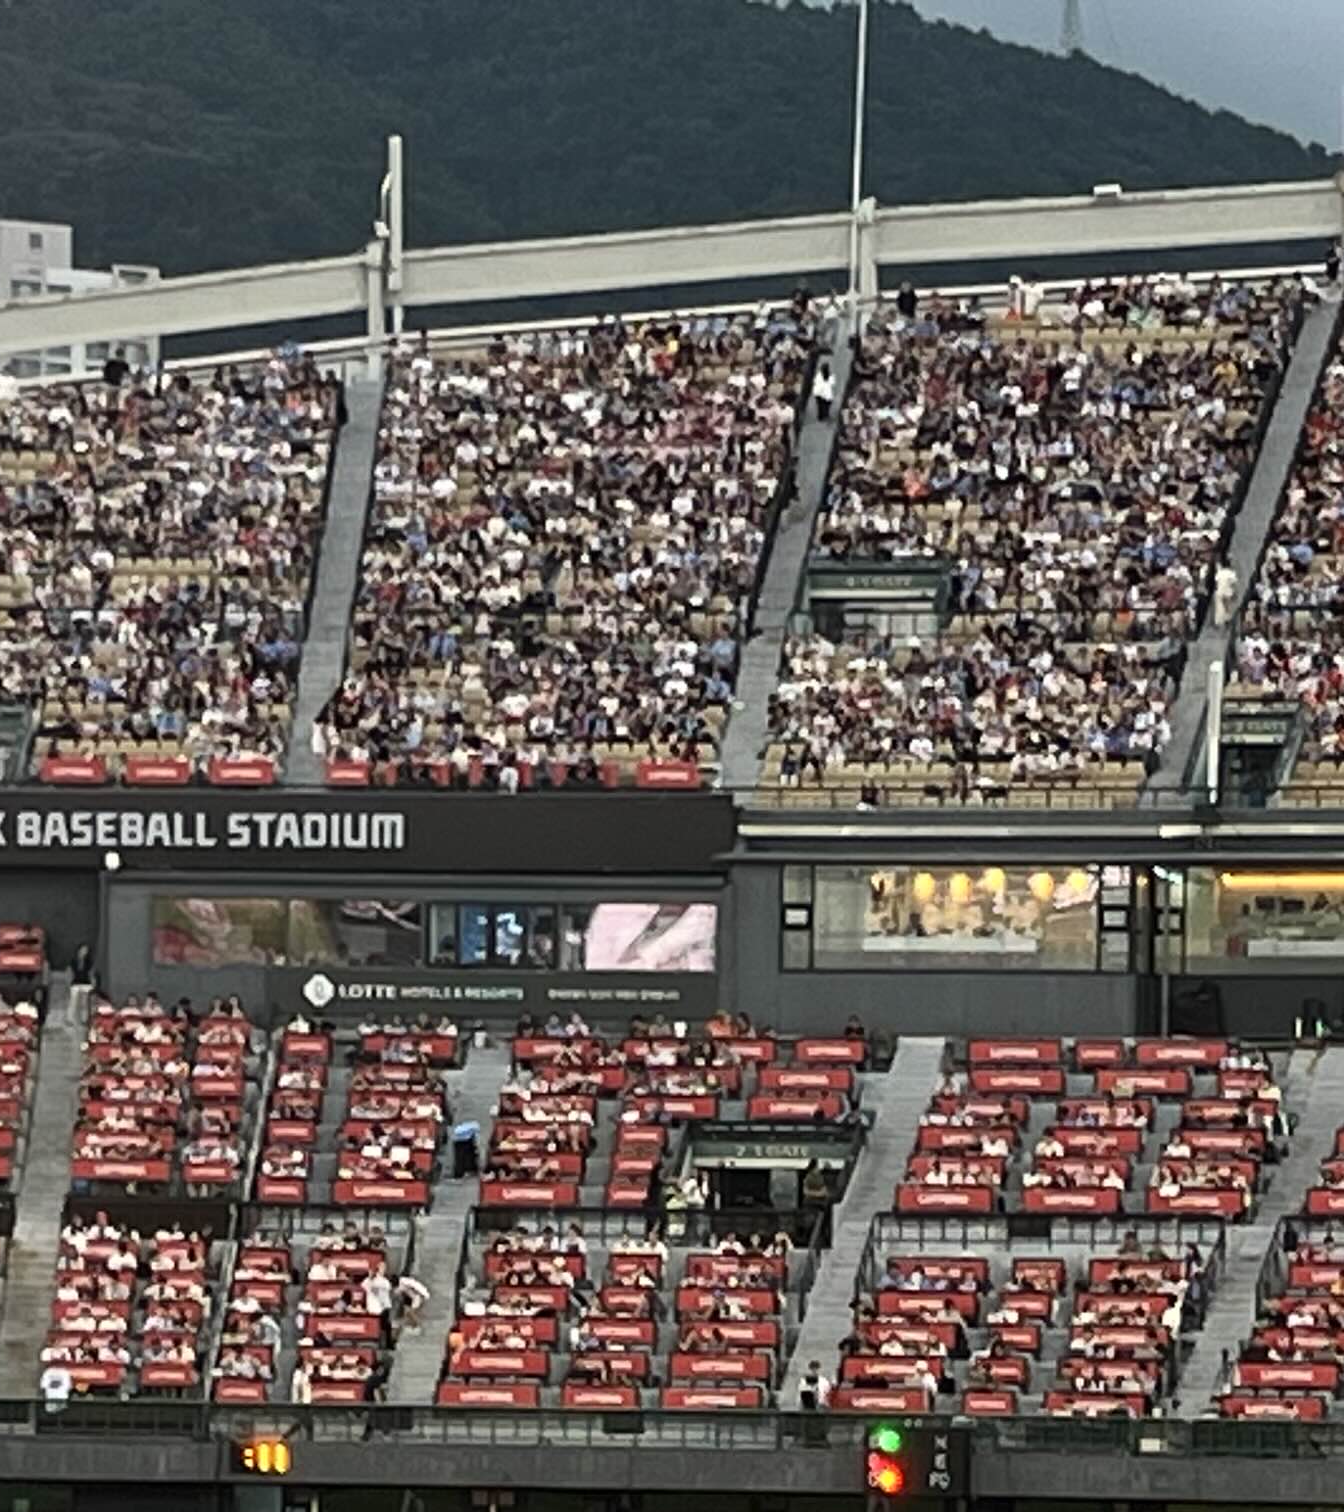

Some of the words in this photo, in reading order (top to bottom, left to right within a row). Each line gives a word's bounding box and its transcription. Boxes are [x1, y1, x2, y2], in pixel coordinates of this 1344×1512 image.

[17, 811, 217, 847] BASEBALL
[227, 812, 405, 849] STADIUM
[338, 984, 397, 998] LOTTE
